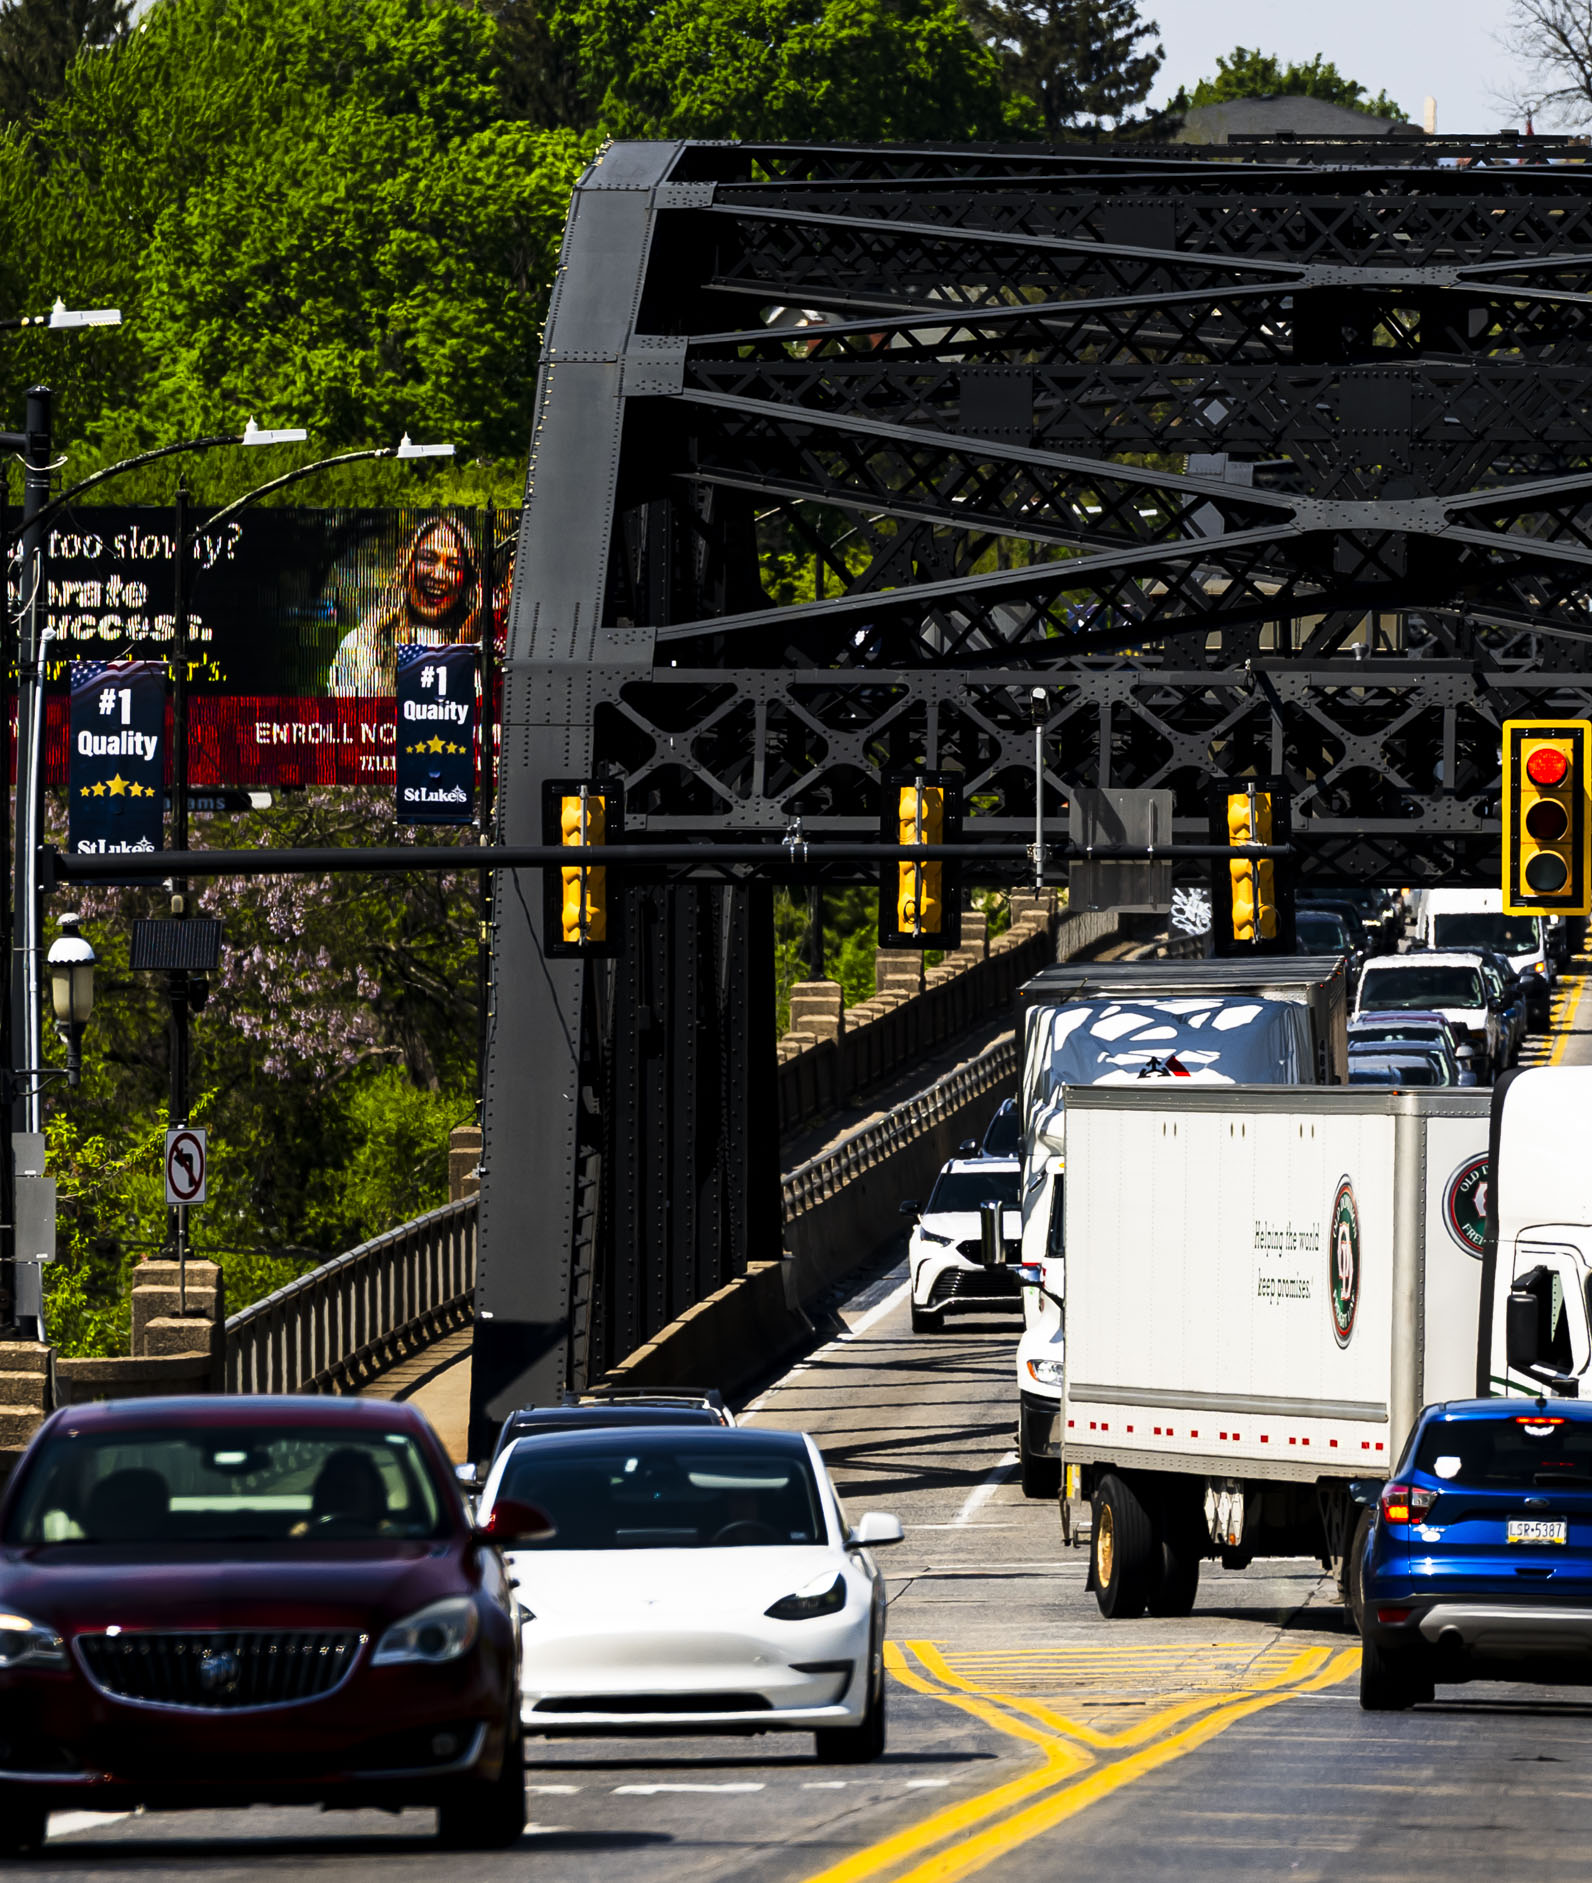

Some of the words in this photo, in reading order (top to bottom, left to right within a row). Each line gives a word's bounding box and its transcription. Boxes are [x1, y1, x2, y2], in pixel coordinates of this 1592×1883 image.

[49, 529, 103, 560] too
[420, 666, 447, 695] #1
[99, 688, 131, 725] #1
[403, 700, 469, 724] Quality
[78, 731, 158, 761] Quality
[255, 722, 354, 744] ENROLL
[1460, 1170, 1479, 1192] OLD
[1254, 1220, 1284, 1258] Helping
[1285, 1221, 1297, 1251] the
[1299, 1222, 1320, 1251] world
[1257, 1267, 1275, 1305] keep
